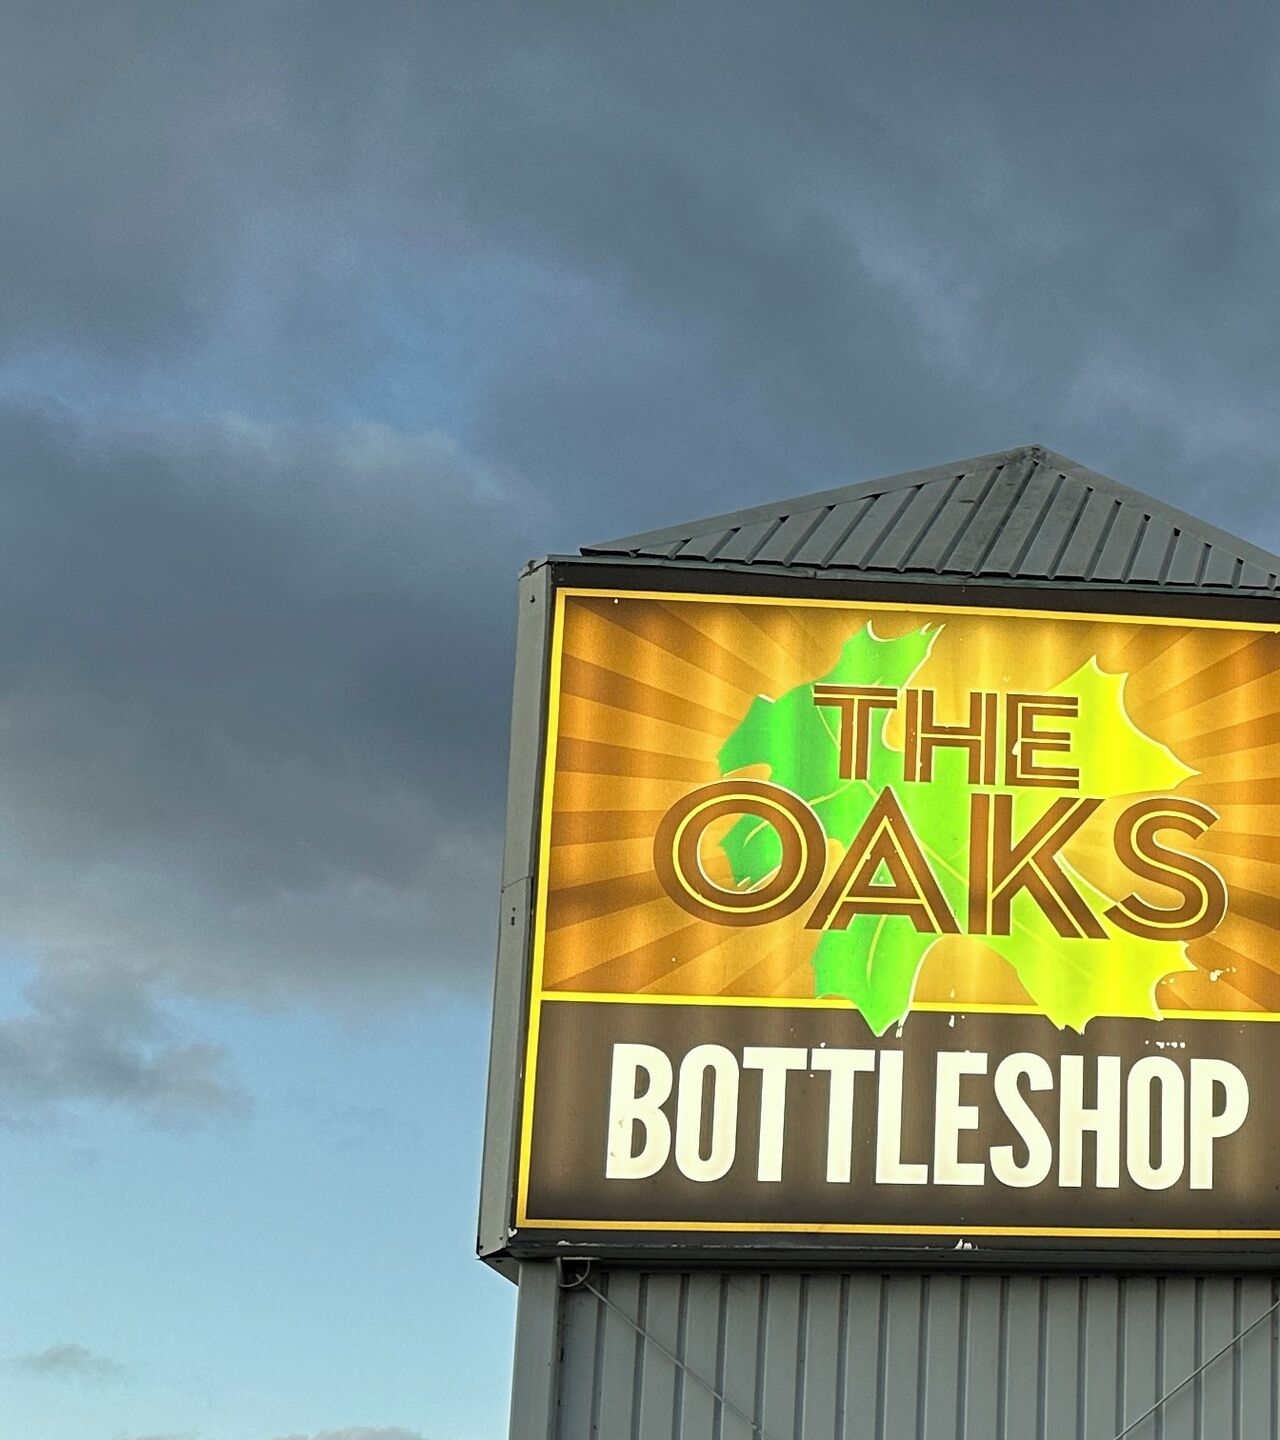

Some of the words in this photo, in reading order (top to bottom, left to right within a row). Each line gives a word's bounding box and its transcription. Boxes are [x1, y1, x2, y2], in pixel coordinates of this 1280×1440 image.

[813, 685, 1080, 789] THE
[653, 780, 1230, 943] OAKS
[604, 1042, 1251, 1191] BOTTLESHOP
